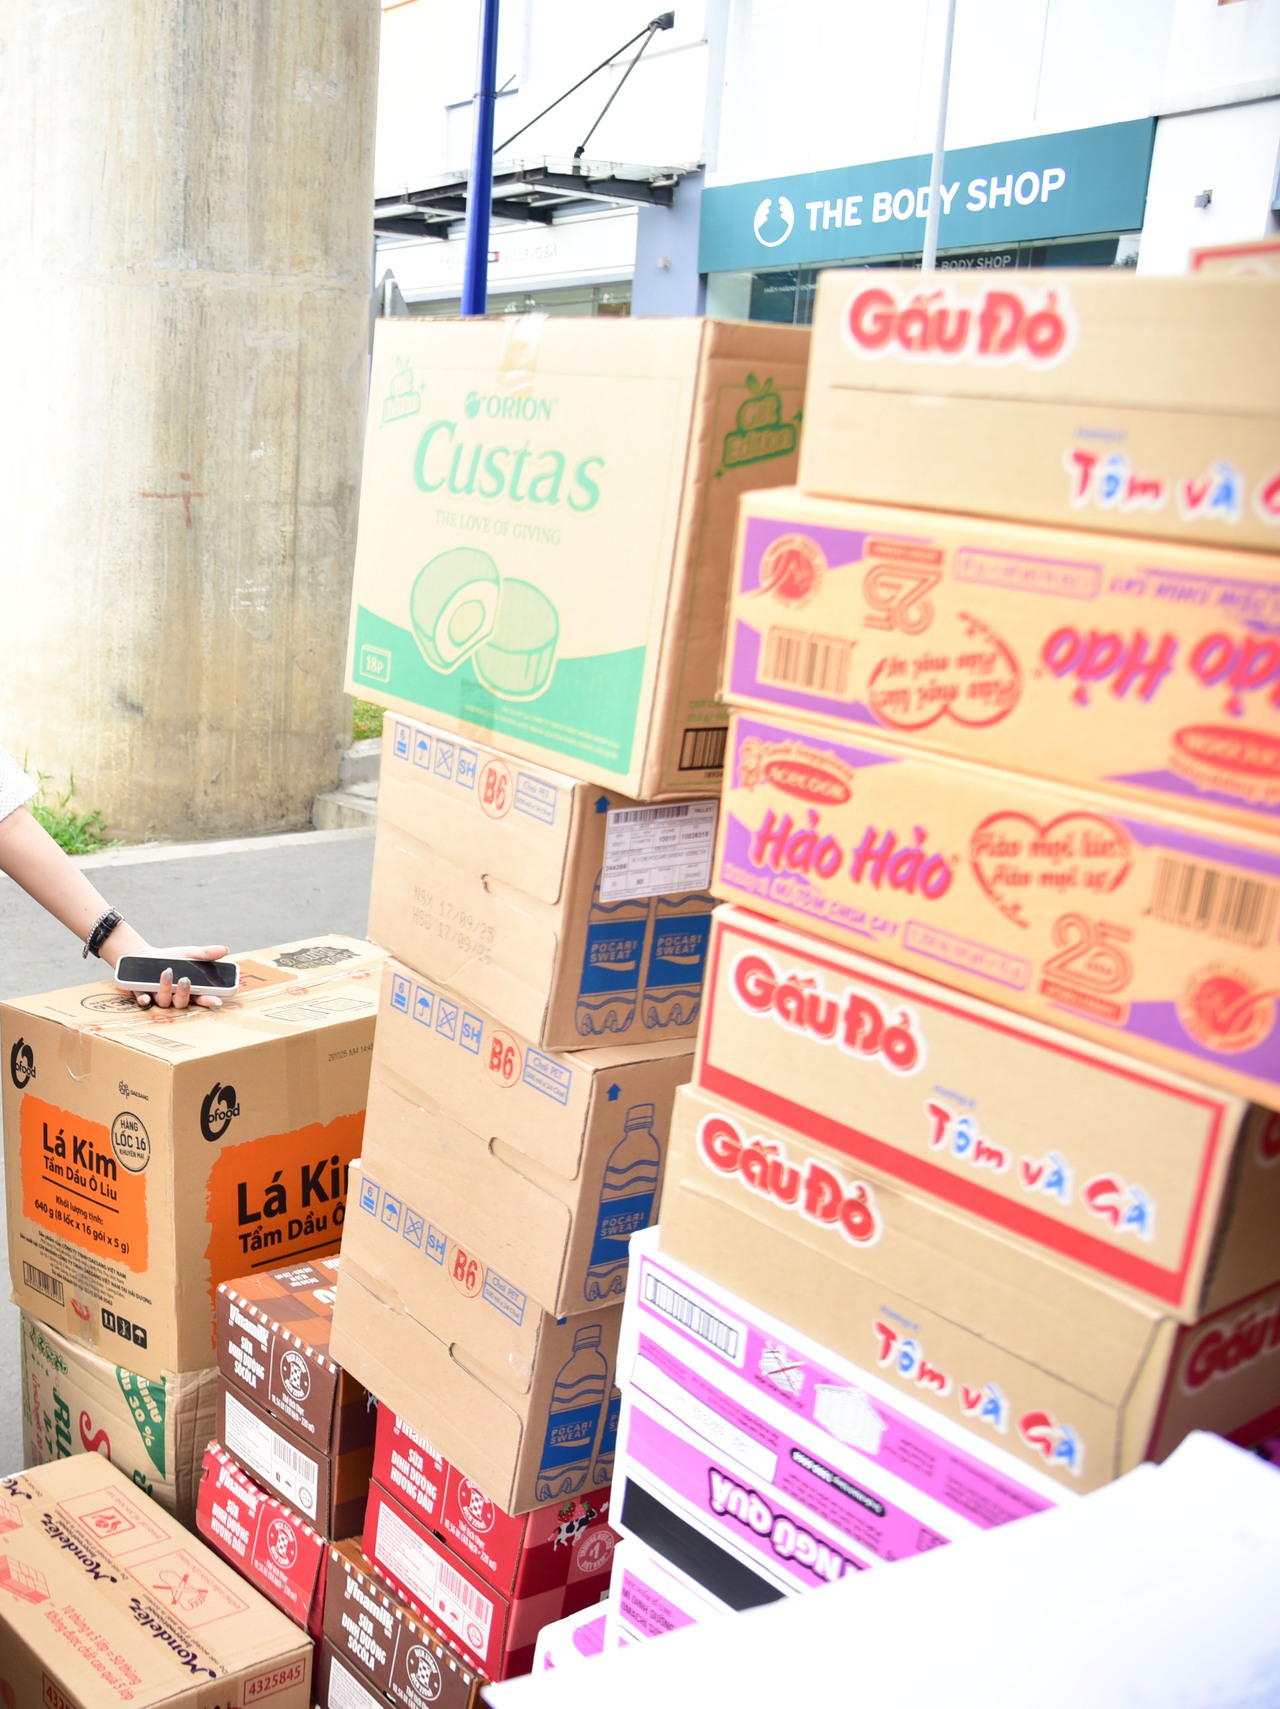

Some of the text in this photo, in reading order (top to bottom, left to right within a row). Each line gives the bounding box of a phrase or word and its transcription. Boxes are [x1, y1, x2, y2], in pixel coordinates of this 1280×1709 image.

[805, 167, 1066, 231] THE BODY SHOP
[976, 255, 1011, 269] SHOP
[849, 287, 970, 353] Gấu
[485, 394, 553, 423] ORION
[412, 418, 607, 513] Custas
[1070, 451, 1162, 501] Tôm
[435, 509, 563, 546] THE LOVE OF GIVING
[459, 759, 476, 778] SH
[483, 767, 508, 810] B6
[753, 808, 842, 879] Hảo
[849, 824, 953, 901] Hảo
[589, 947, 631, 962] SWEAT
[590, 939, 638, 954] POCARI
[656, 934, 702, 948] POCARI
[656, 943, 697, 957] SWEAT
[398, 982, 404, 994] 6
[734, 955, 836, 1040] Gấu
[845, 992, 919, 1070] Đỏ
[462, 1024, 480, 1044] SH
[489, 1037, 515, 1080] B6
[115, 1130, 146, 1151] LỐC 16
[120, 1119, 138, 1131] HÀNG
[43, 1122, 117, 1181] Lá Kim
[925, 1103, 1149, 1233] Tôm và Gà
[43, 1155, 117, 1201] Tẩm Dầu Ô Liu
[367, 1187, 373, 1197] 6
[702, 1117, 876, 1242] Gấu Đỏ
[237, 1170, 287, 1227] Lá
[34, 1199, 47, 1213] 640
[49, 1208, 54, 1219] g
[55, 1211, 62, 1222] (8
[63, 1211, 74, 1227] lốc
[82, 1223, 92, 1235] 16
[93, 1229, 106, 1241] gói
[114, 1238, 119, 1248] 5
[121, 1243, 130, 1254] g)
[238, 1202, 345, 1254] Tẩm Dầu Ô
[601, 1211, 645, 1228] POCARI
[601, 1220, 640, 1235] SWEAT
[428, 1234, 444, 1255] SH
[453, 1248, 478, 1291] B6
[492, 1276, 519, 1301] Chai PET
[229, 1303, 269, 1347] Vinamilk
[129, 1396, 146, 1422] 30
[875, 1321, 1081, 1470] Tôm và Gà
[550, 1429, 590, 1444] SWEAT
[551, 1421, 593, 1436] POCARI
[391, 1449, 409, 1477] DINH
[218, 1466, 258, 1512] Vinamilk
[709, 1471, 774, 1534] QUẢ
[346, 1575, 394, 1633] Vinamilk
[129, 1597, 217, 1679] Mondelēz
[341, 1612, 360, 1639] DINH
[248, 1665, 301, 1696] 4325845
